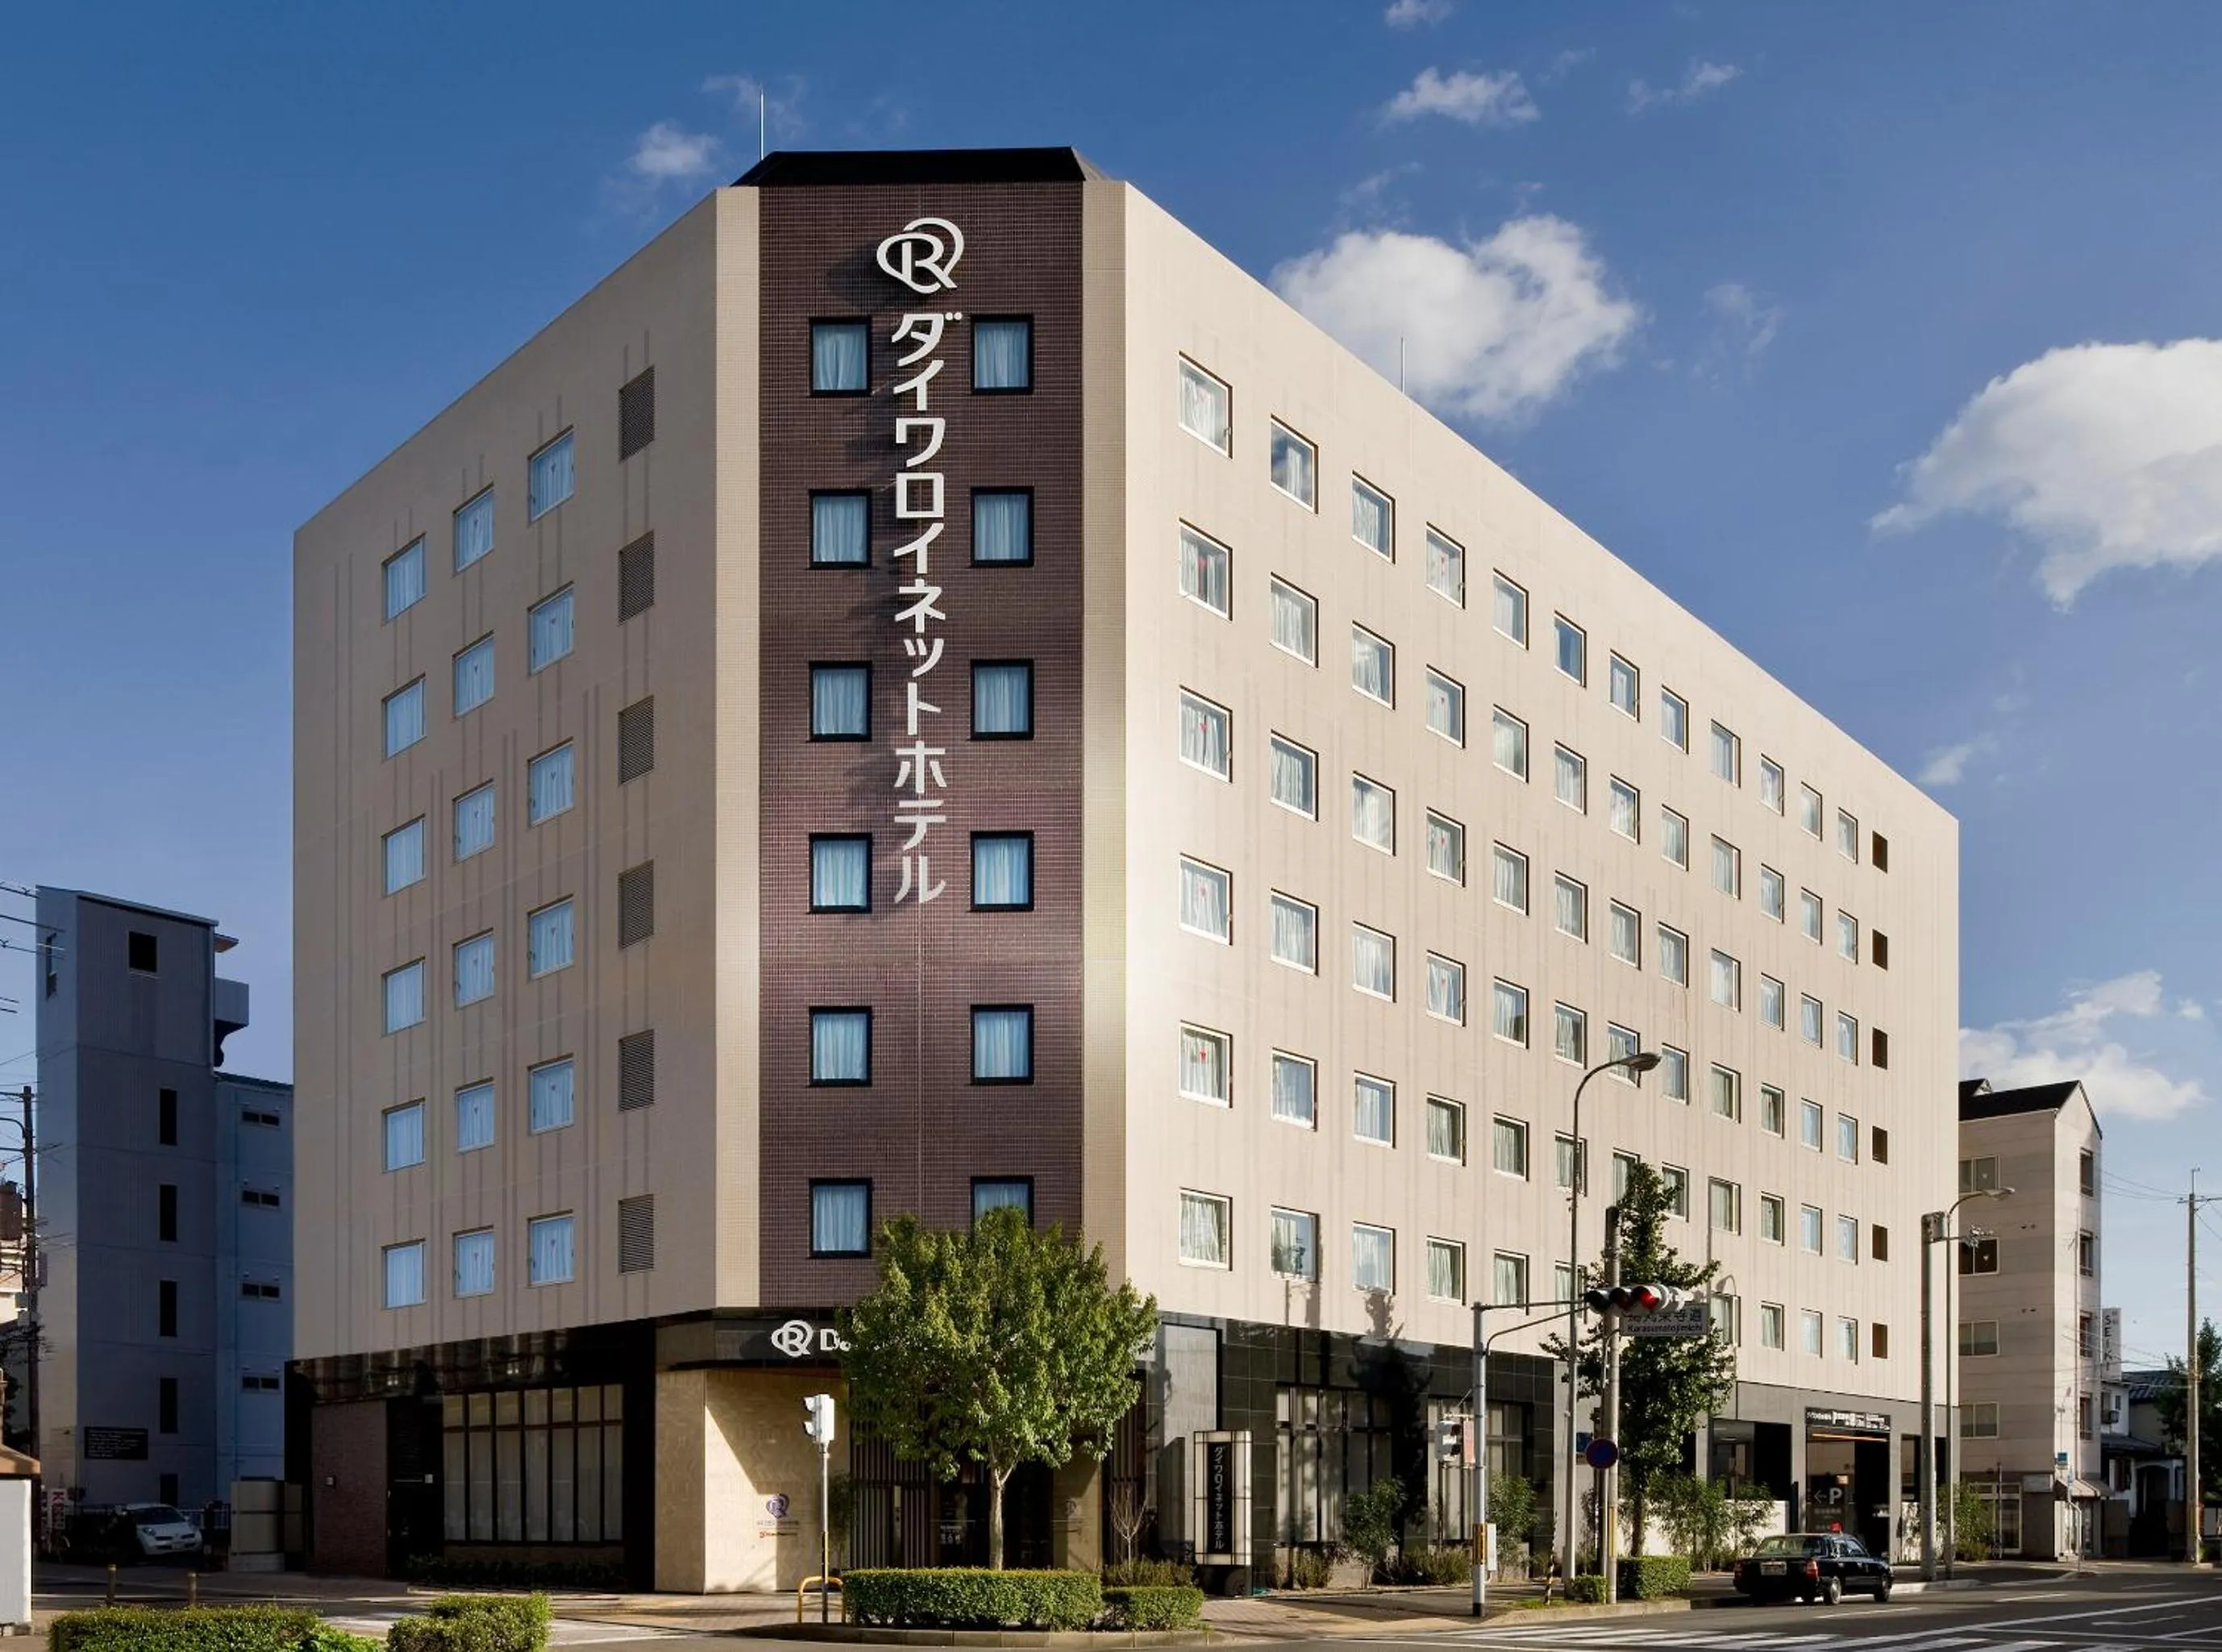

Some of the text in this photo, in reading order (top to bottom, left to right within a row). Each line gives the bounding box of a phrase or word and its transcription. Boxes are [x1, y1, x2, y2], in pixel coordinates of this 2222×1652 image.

[892, 312, 963, 904] ダイワロイネットホテル
[1213, 1446, 1225, 1550] ダイワロイネットホテル
[1829, 1488, 1842, 1504] P
